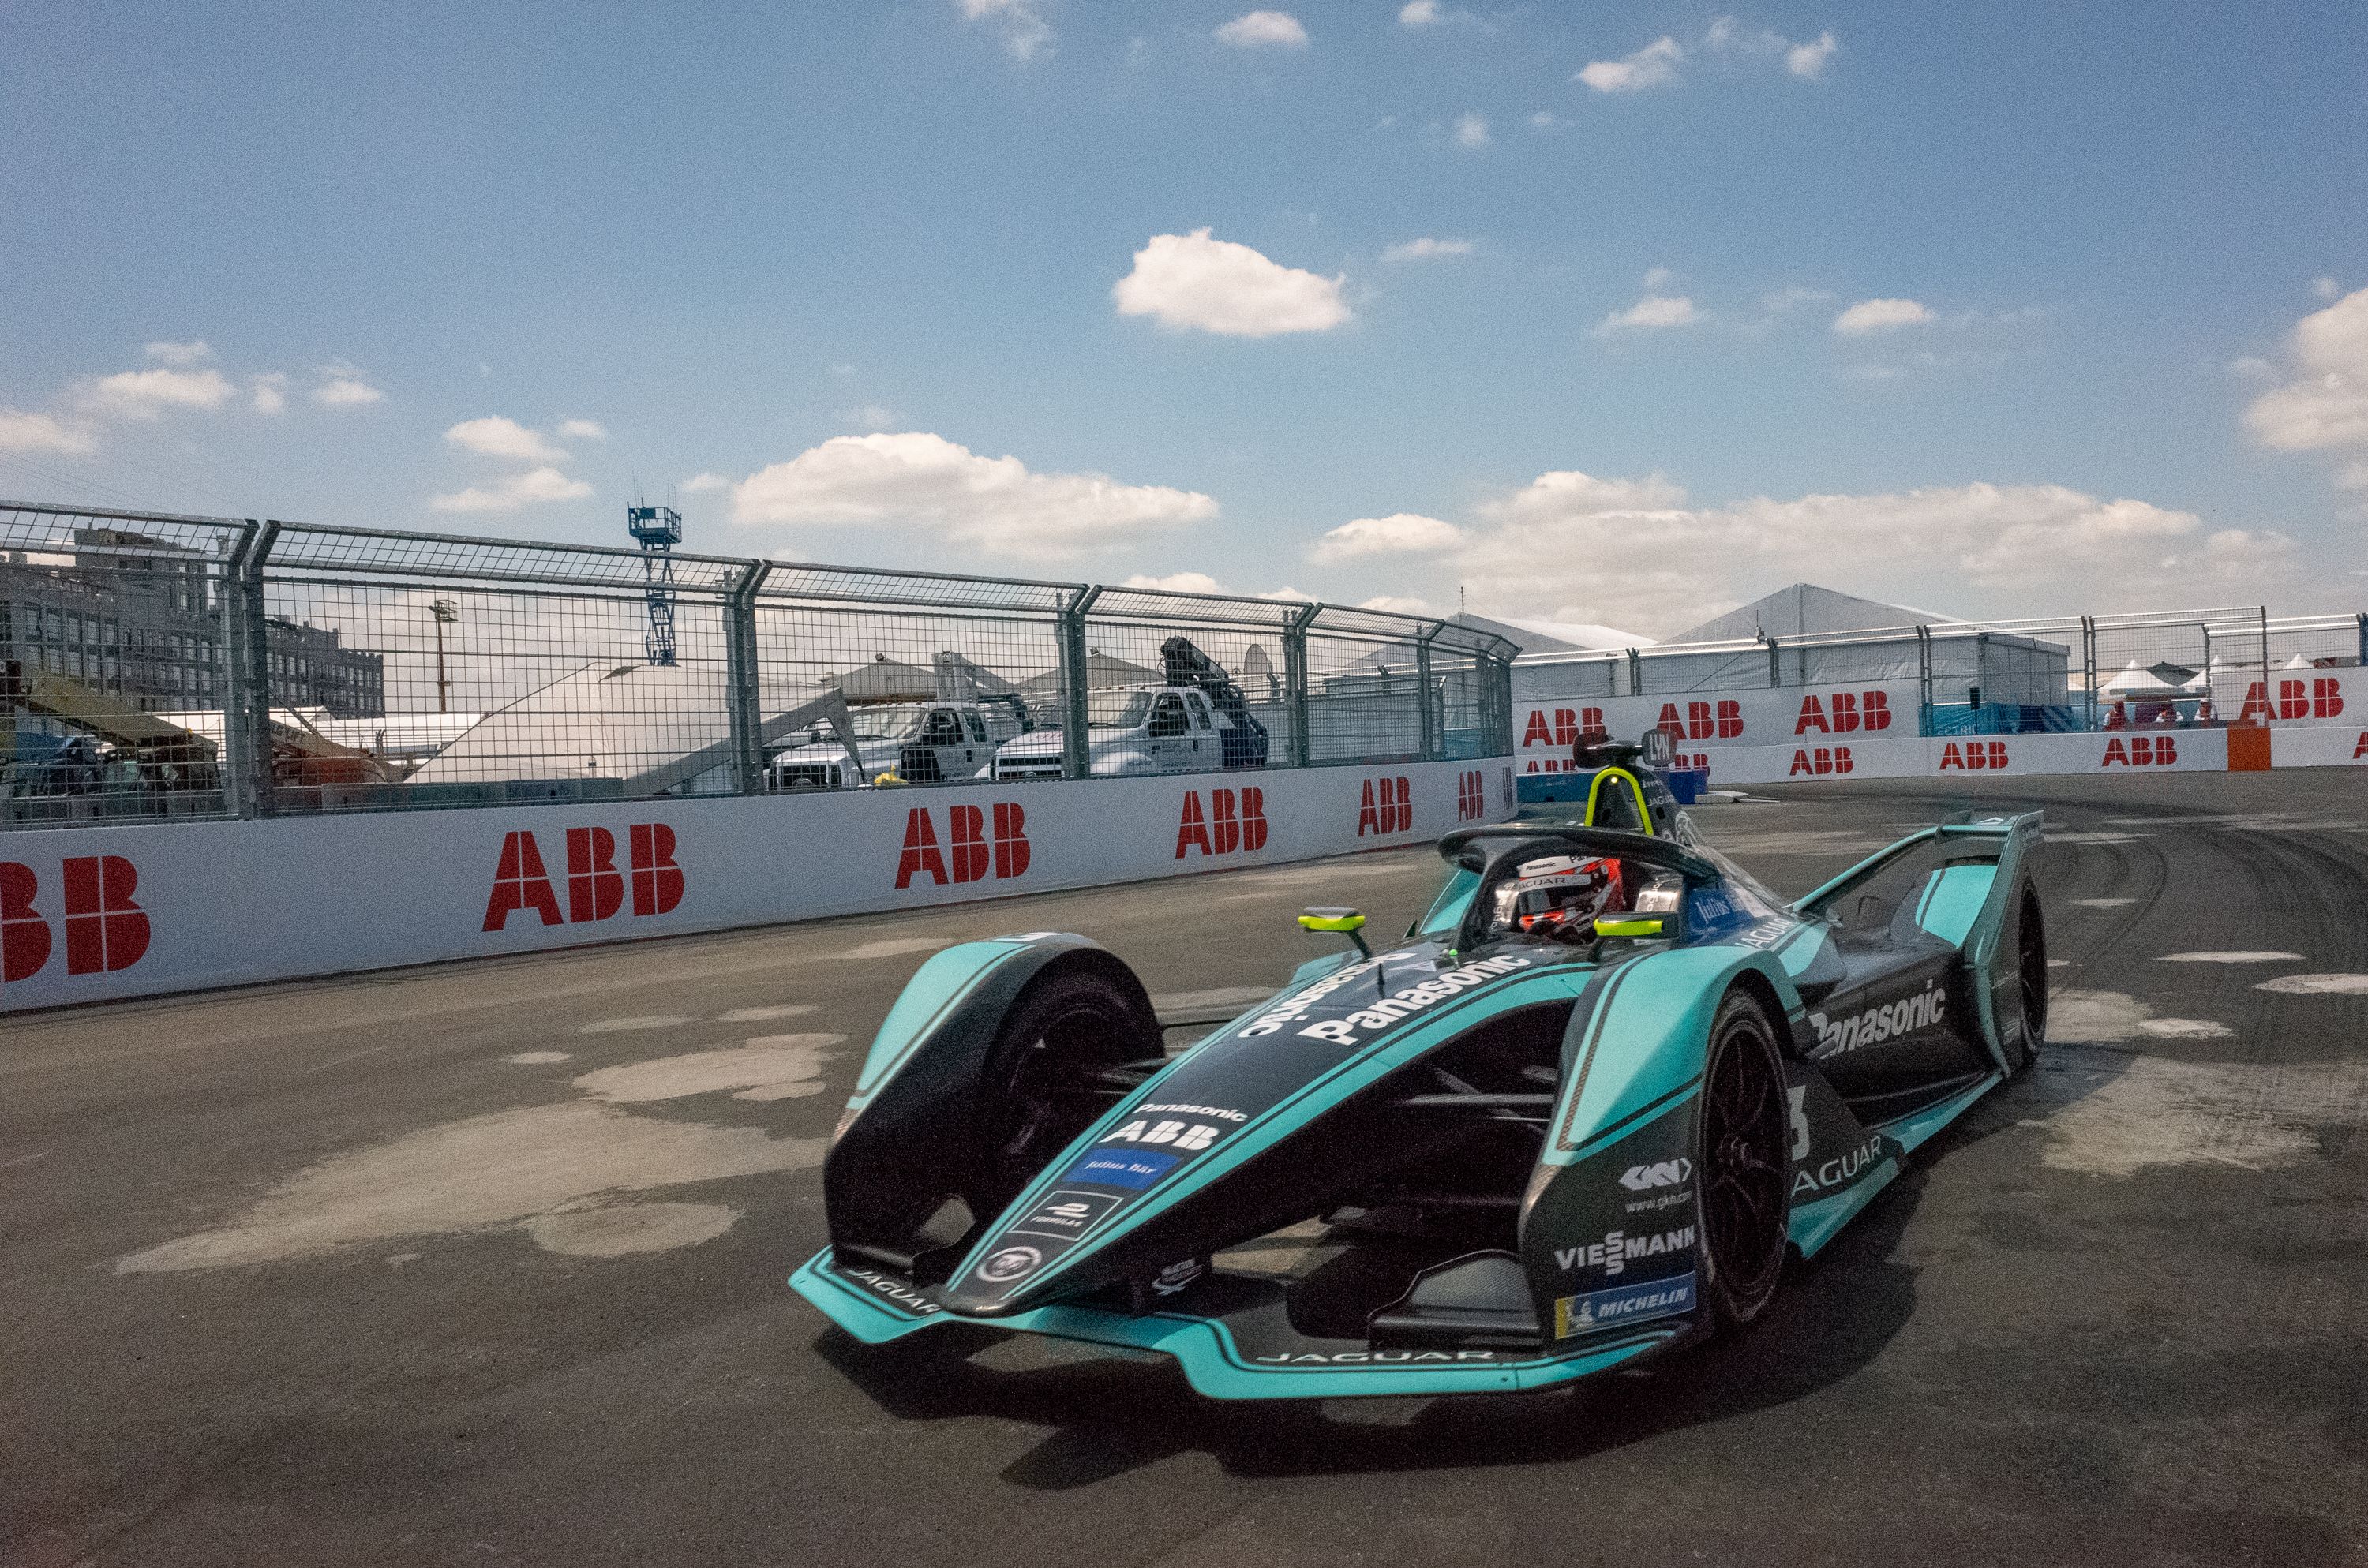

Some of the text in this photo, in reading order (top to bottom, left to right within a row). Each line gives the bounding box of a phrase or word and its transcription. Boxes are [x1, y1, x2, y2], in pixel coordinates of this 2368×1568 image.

[1794, 690, 1893, 735] ABB
[2239, 677, 2344, 720] ABB
[1523, 707, 1606, 747] ABB
[1656, 699, 1744, 740] ABB
[1650, 733, 1669, 761] LYN
[1789, 747, 1854, 776] ABB
[1939, 741, 2009, 770] ABB
[2102, 735, 2178, 767] ABB
[1358, 776, 1412, 837] ABB
[1458, 770, 1483, 822] ABB
[1175, 787, 1268, 859] ABB
[895, 802, 1031, 889] ABB
[483, 823, 685, 932] ABB
[1519, 877, 1566, 889] AGUAR
[1526, 862, 1556, 870] Panasonic
[0, 855, 152, 983] BB
[1297, 954, 1531, 1046] Panasonic
[1133, 1103, 1249, 1122] Panasonic
[1098, 1120, 1220, 1151] ABB
[1084, 1161, 1127, 1169] Julius
[1790, 1135, 1882, 1199] AGUAR
[846, 1270, 942, 1314] JAGUAR
[1598, 1287, 1689, 1318] MICHELIN
[1256, 1351, 1494, 1363] JAGUAR
